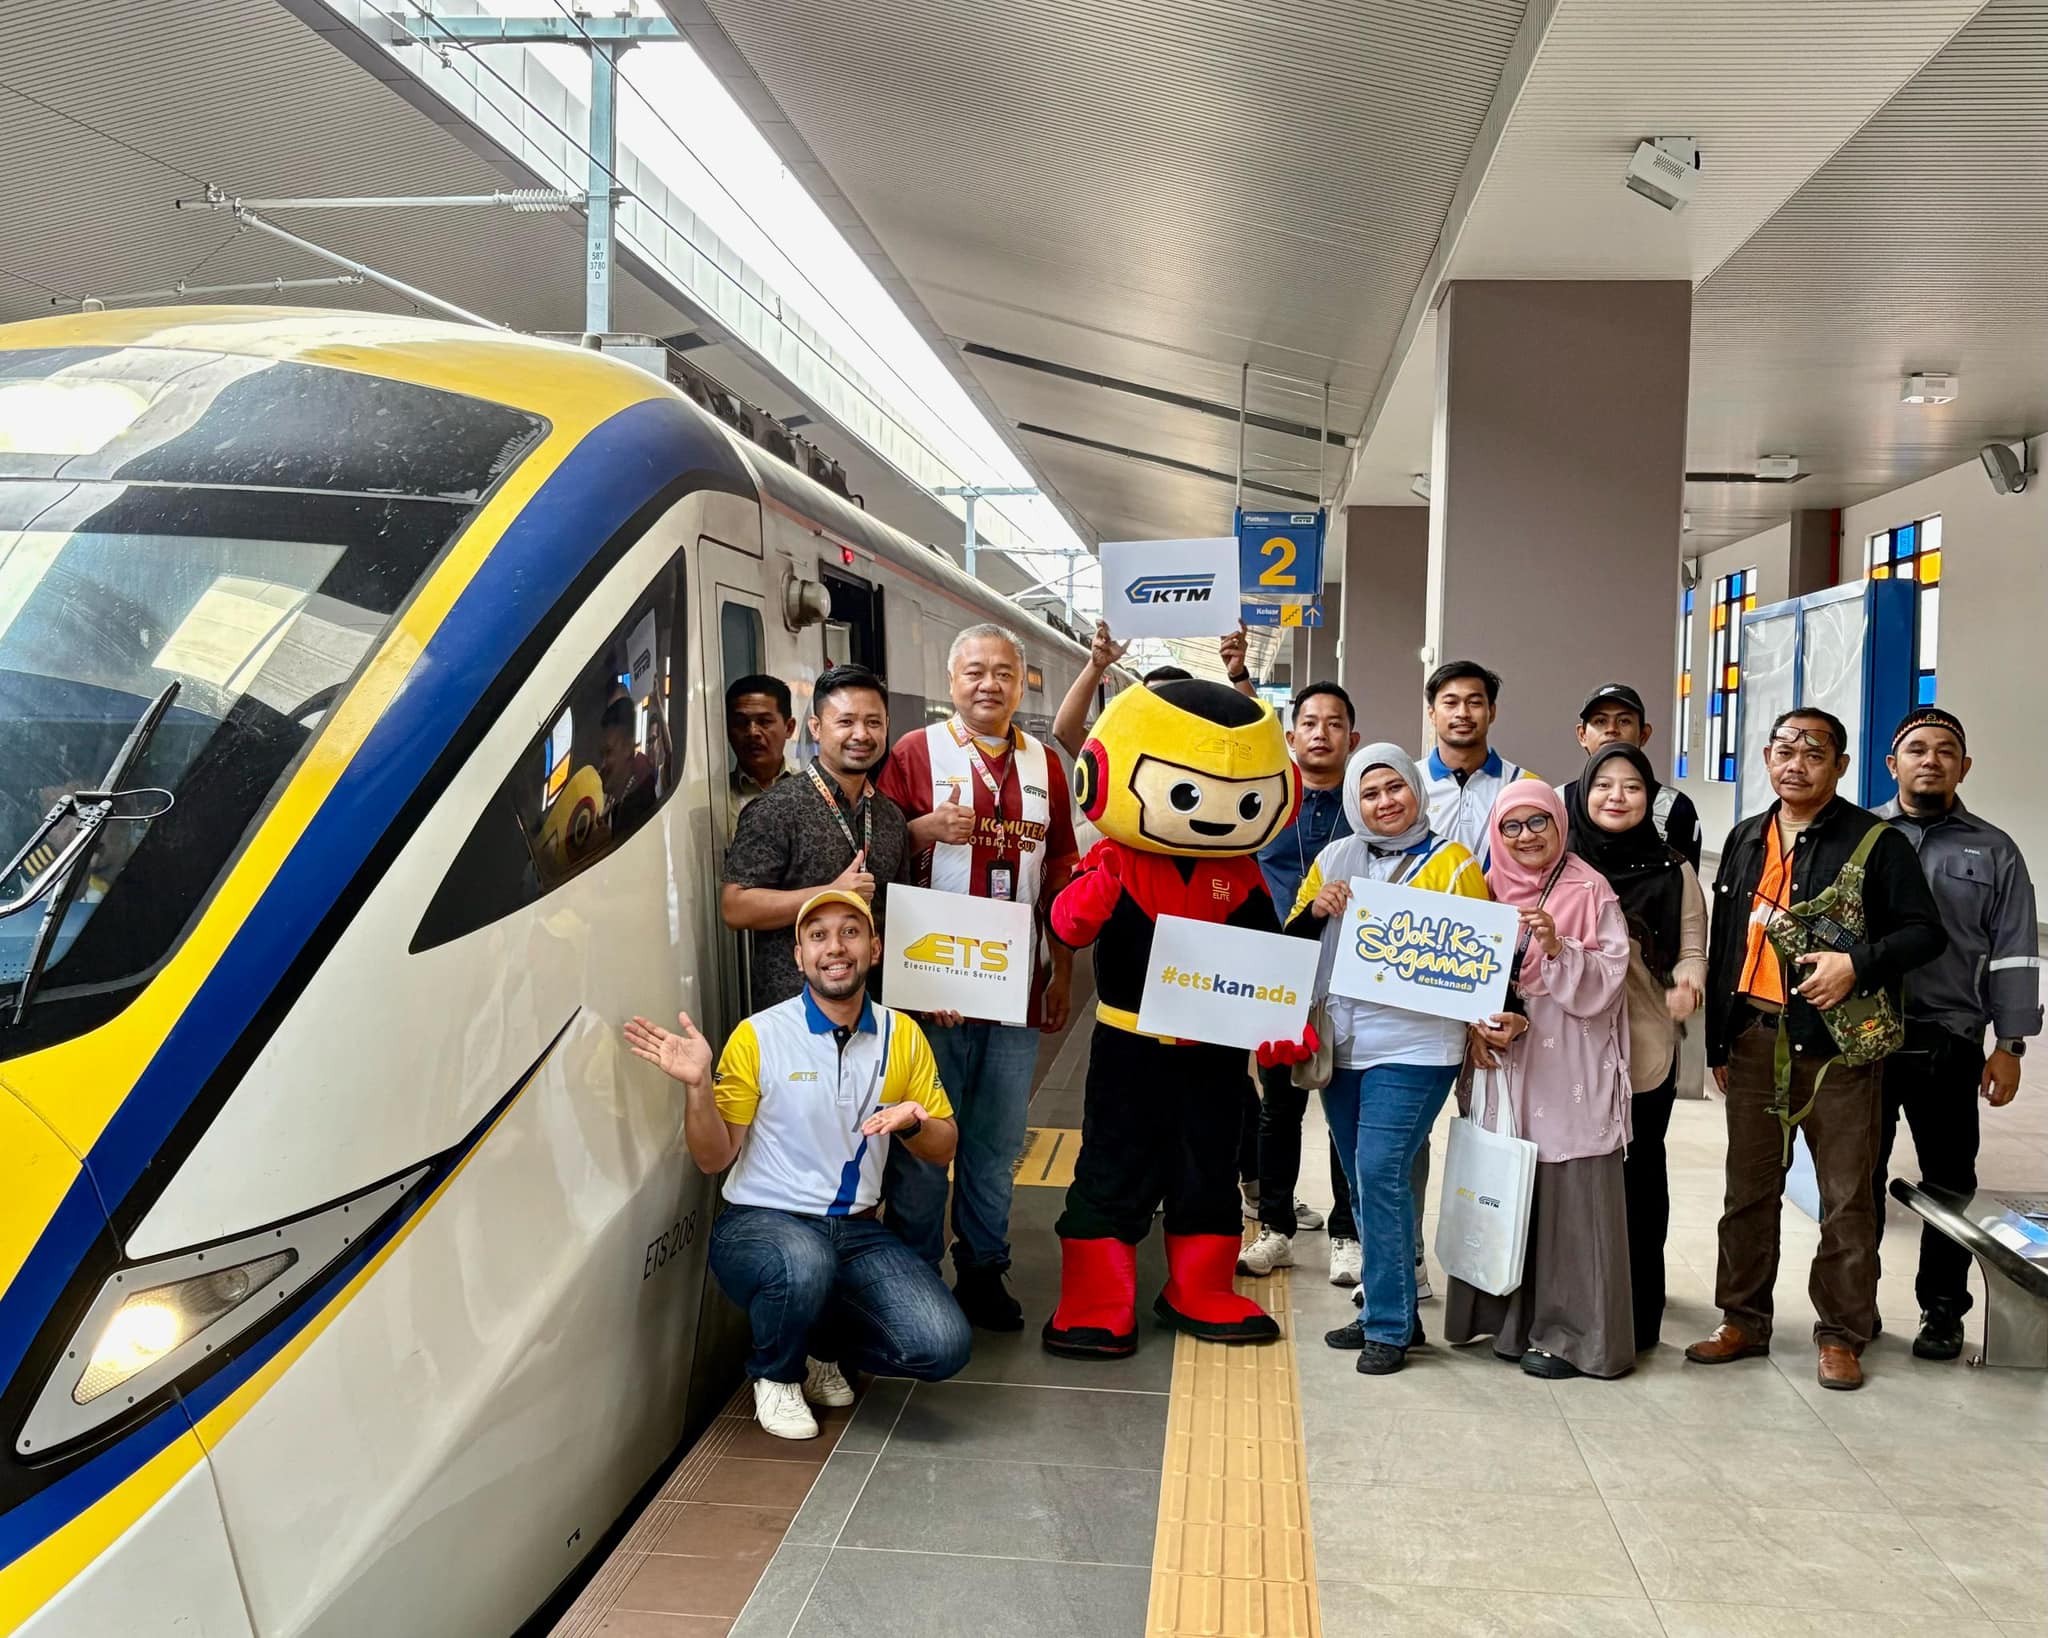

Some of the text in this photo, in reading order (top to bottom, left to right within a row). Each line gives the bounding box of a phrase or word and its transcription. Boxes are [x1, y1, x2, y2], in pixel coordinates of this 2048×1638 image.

[592, 252, 604, 260] 587
[594, 242, 601, 250] M
[594, 271, 601, 280] D
[1259, 537, 1297, 586] 2
[1152, 588, 1211, 603] KTM
[904, 933, 1009, 972] ETS
[1450, 924, 1485, 957] Ke
[1357, 926, 1499, 983] Segamat
[903, 961, 1007, 982] Electric Train Service
[1161, 965, 1297, 1005] #etskanada
[1417, 974, 1473, 991] #etskanada
[643, 1209, 696, 1280] ETS 208
